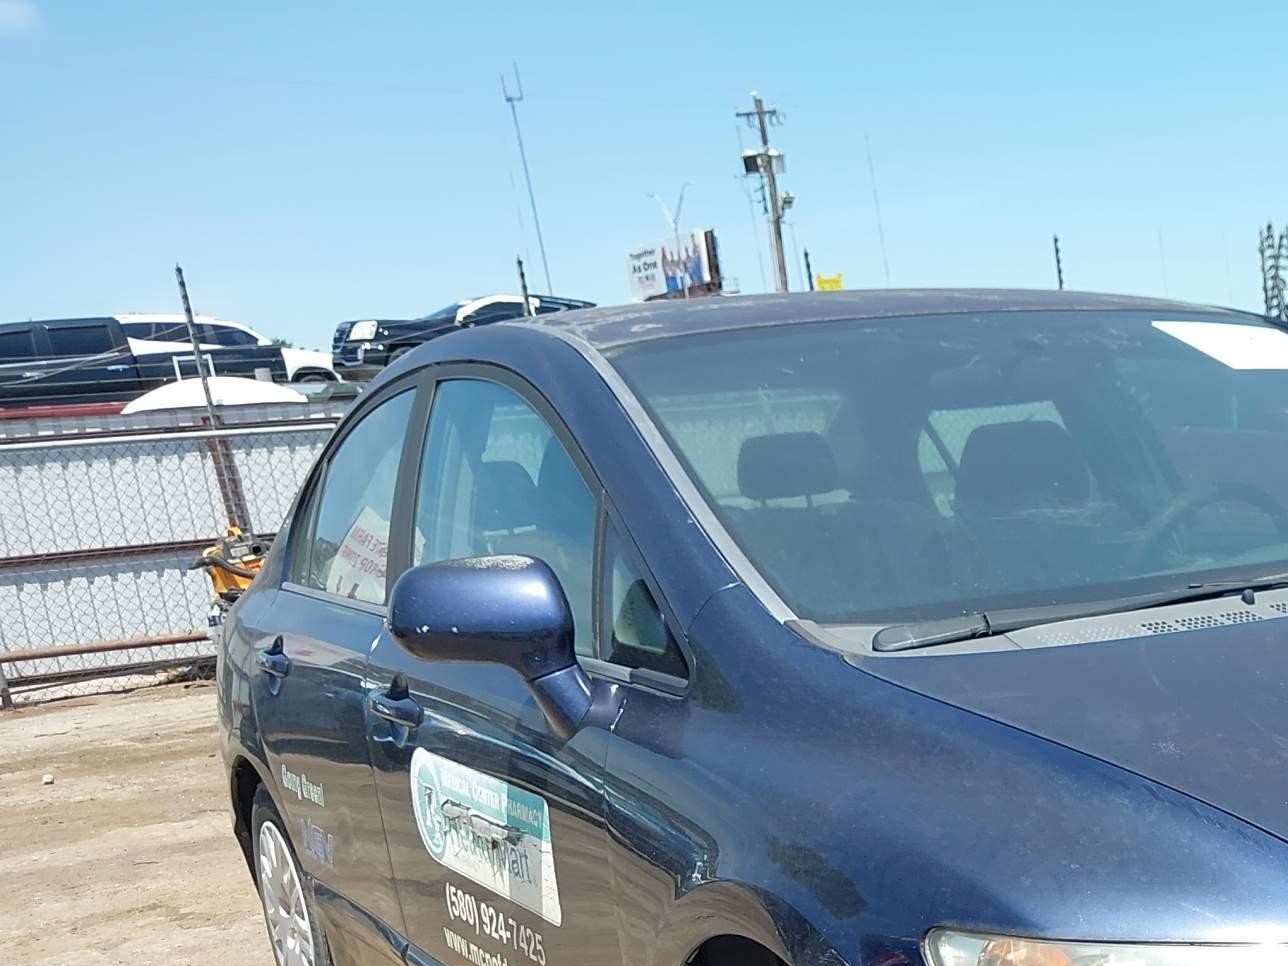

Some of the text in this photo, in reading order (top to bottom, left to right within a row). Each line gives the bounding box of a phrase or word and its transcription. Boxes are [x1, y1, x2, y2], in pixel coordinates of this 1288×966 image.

[500, 789, 543, 829] PHARMACY
[445, 881, 547, 966] (580) 924-7425
